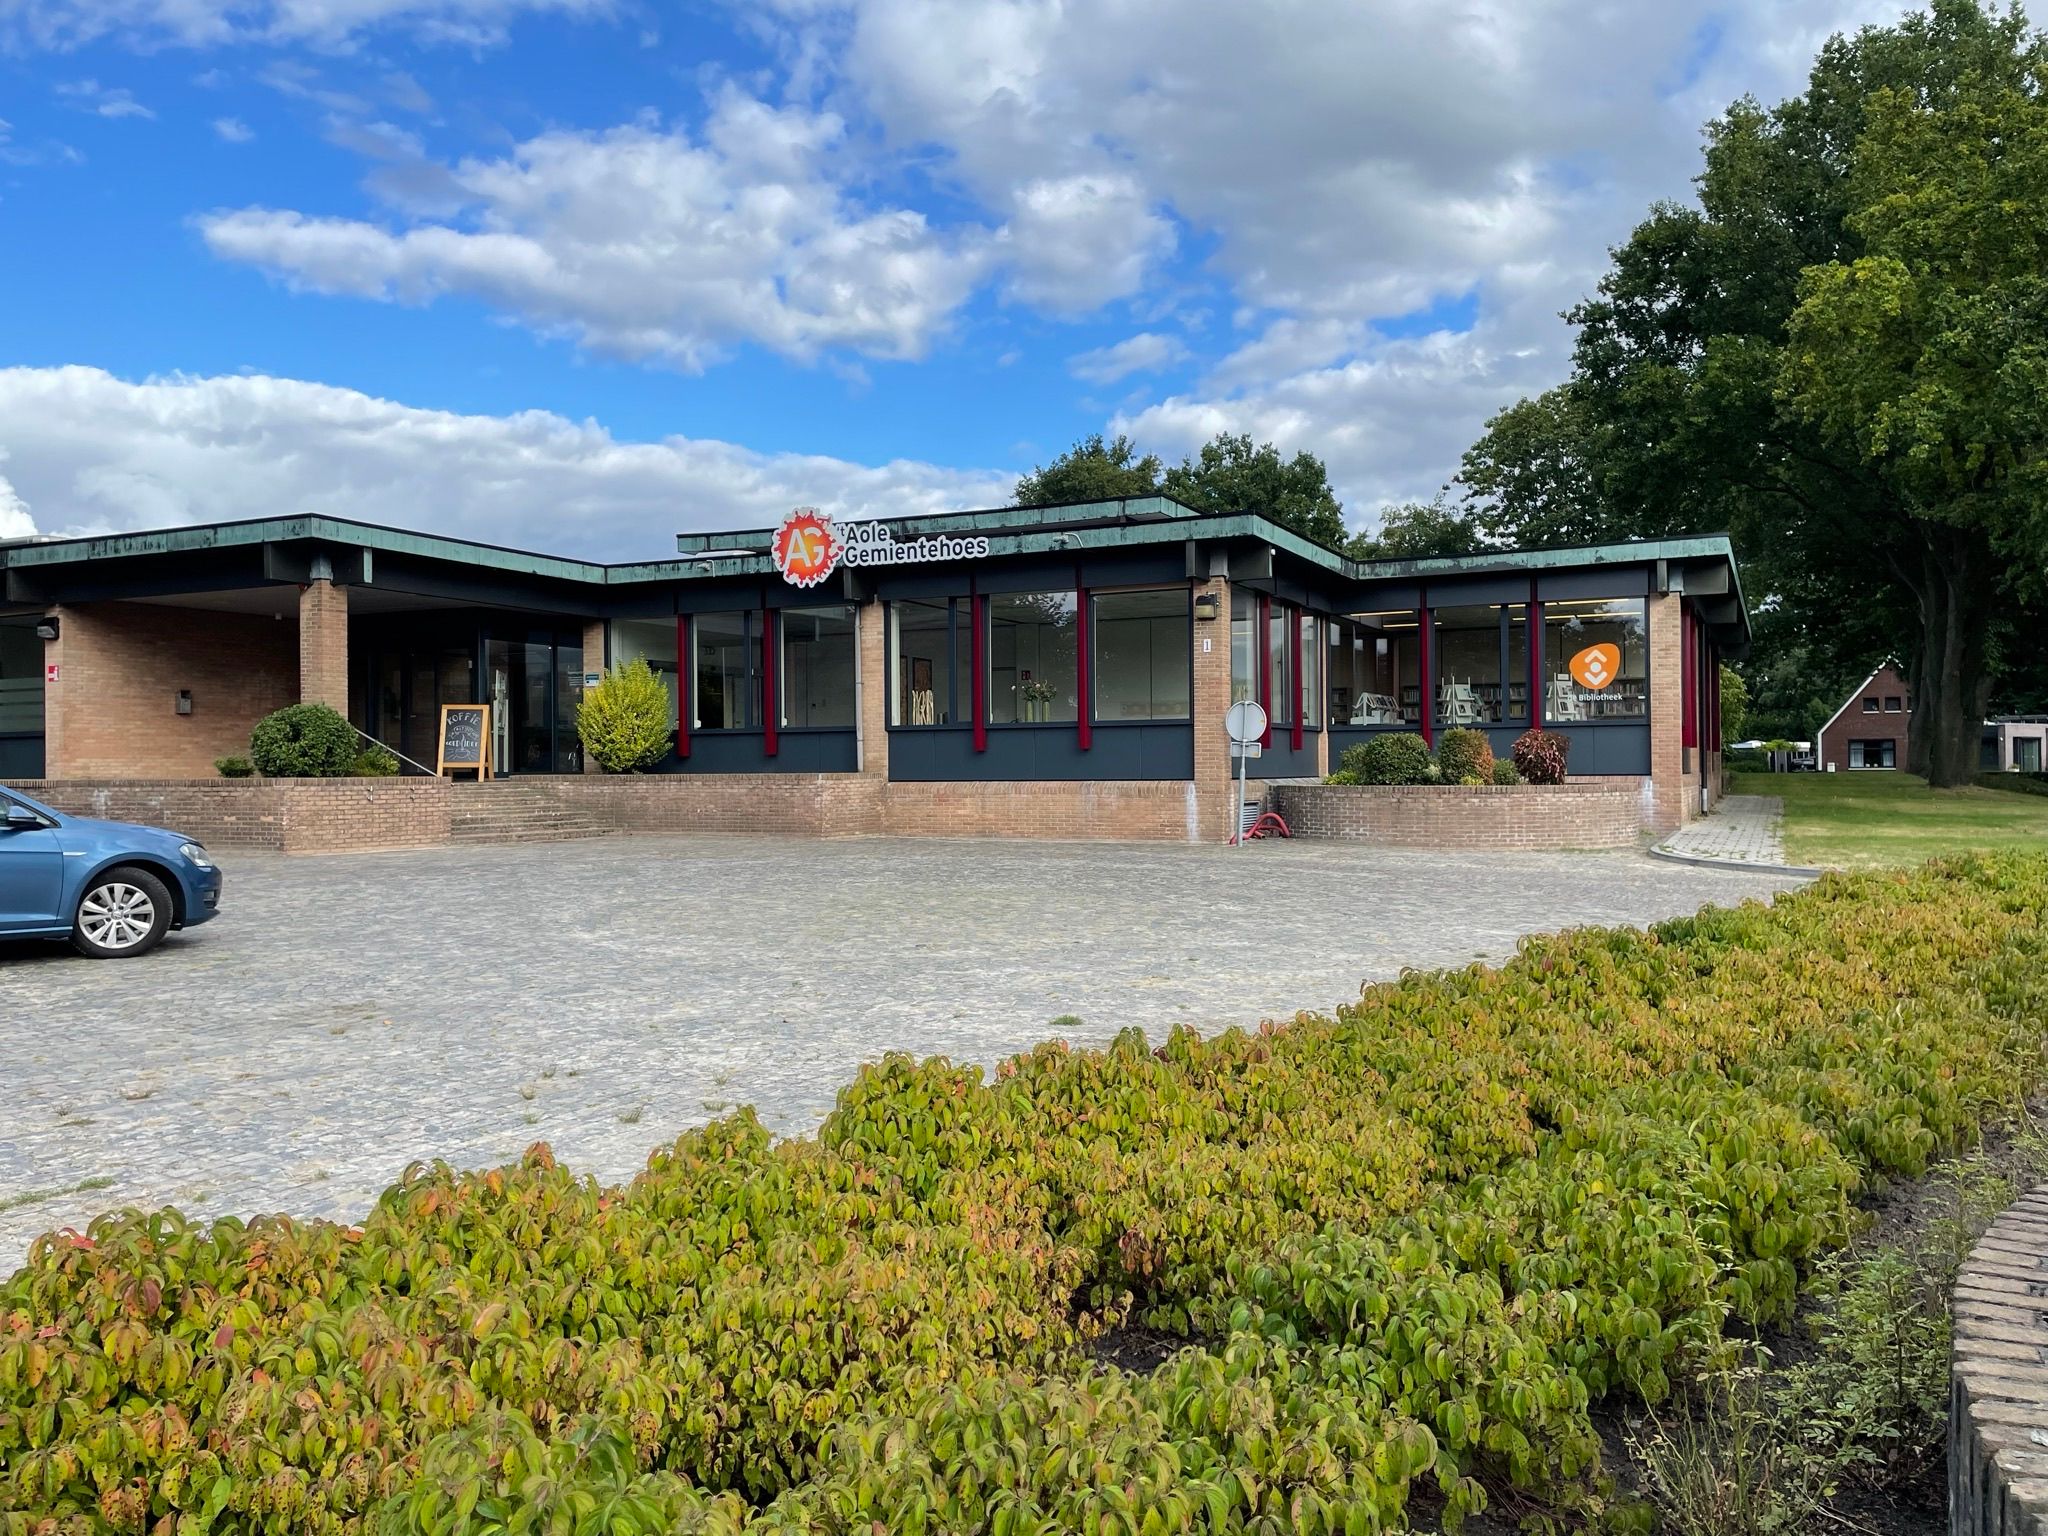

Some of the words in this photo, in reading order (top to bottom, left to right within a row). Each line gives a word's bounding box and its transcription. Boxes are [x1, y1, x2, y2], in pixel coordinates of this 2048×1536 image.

[845, 524, 888, 545] Aole
[845, 539, 987, 564] Gemientehoes
[1578, 692, 1623, 702] Bibliotheek
[446, 712, 481, 726] KOFFIE
